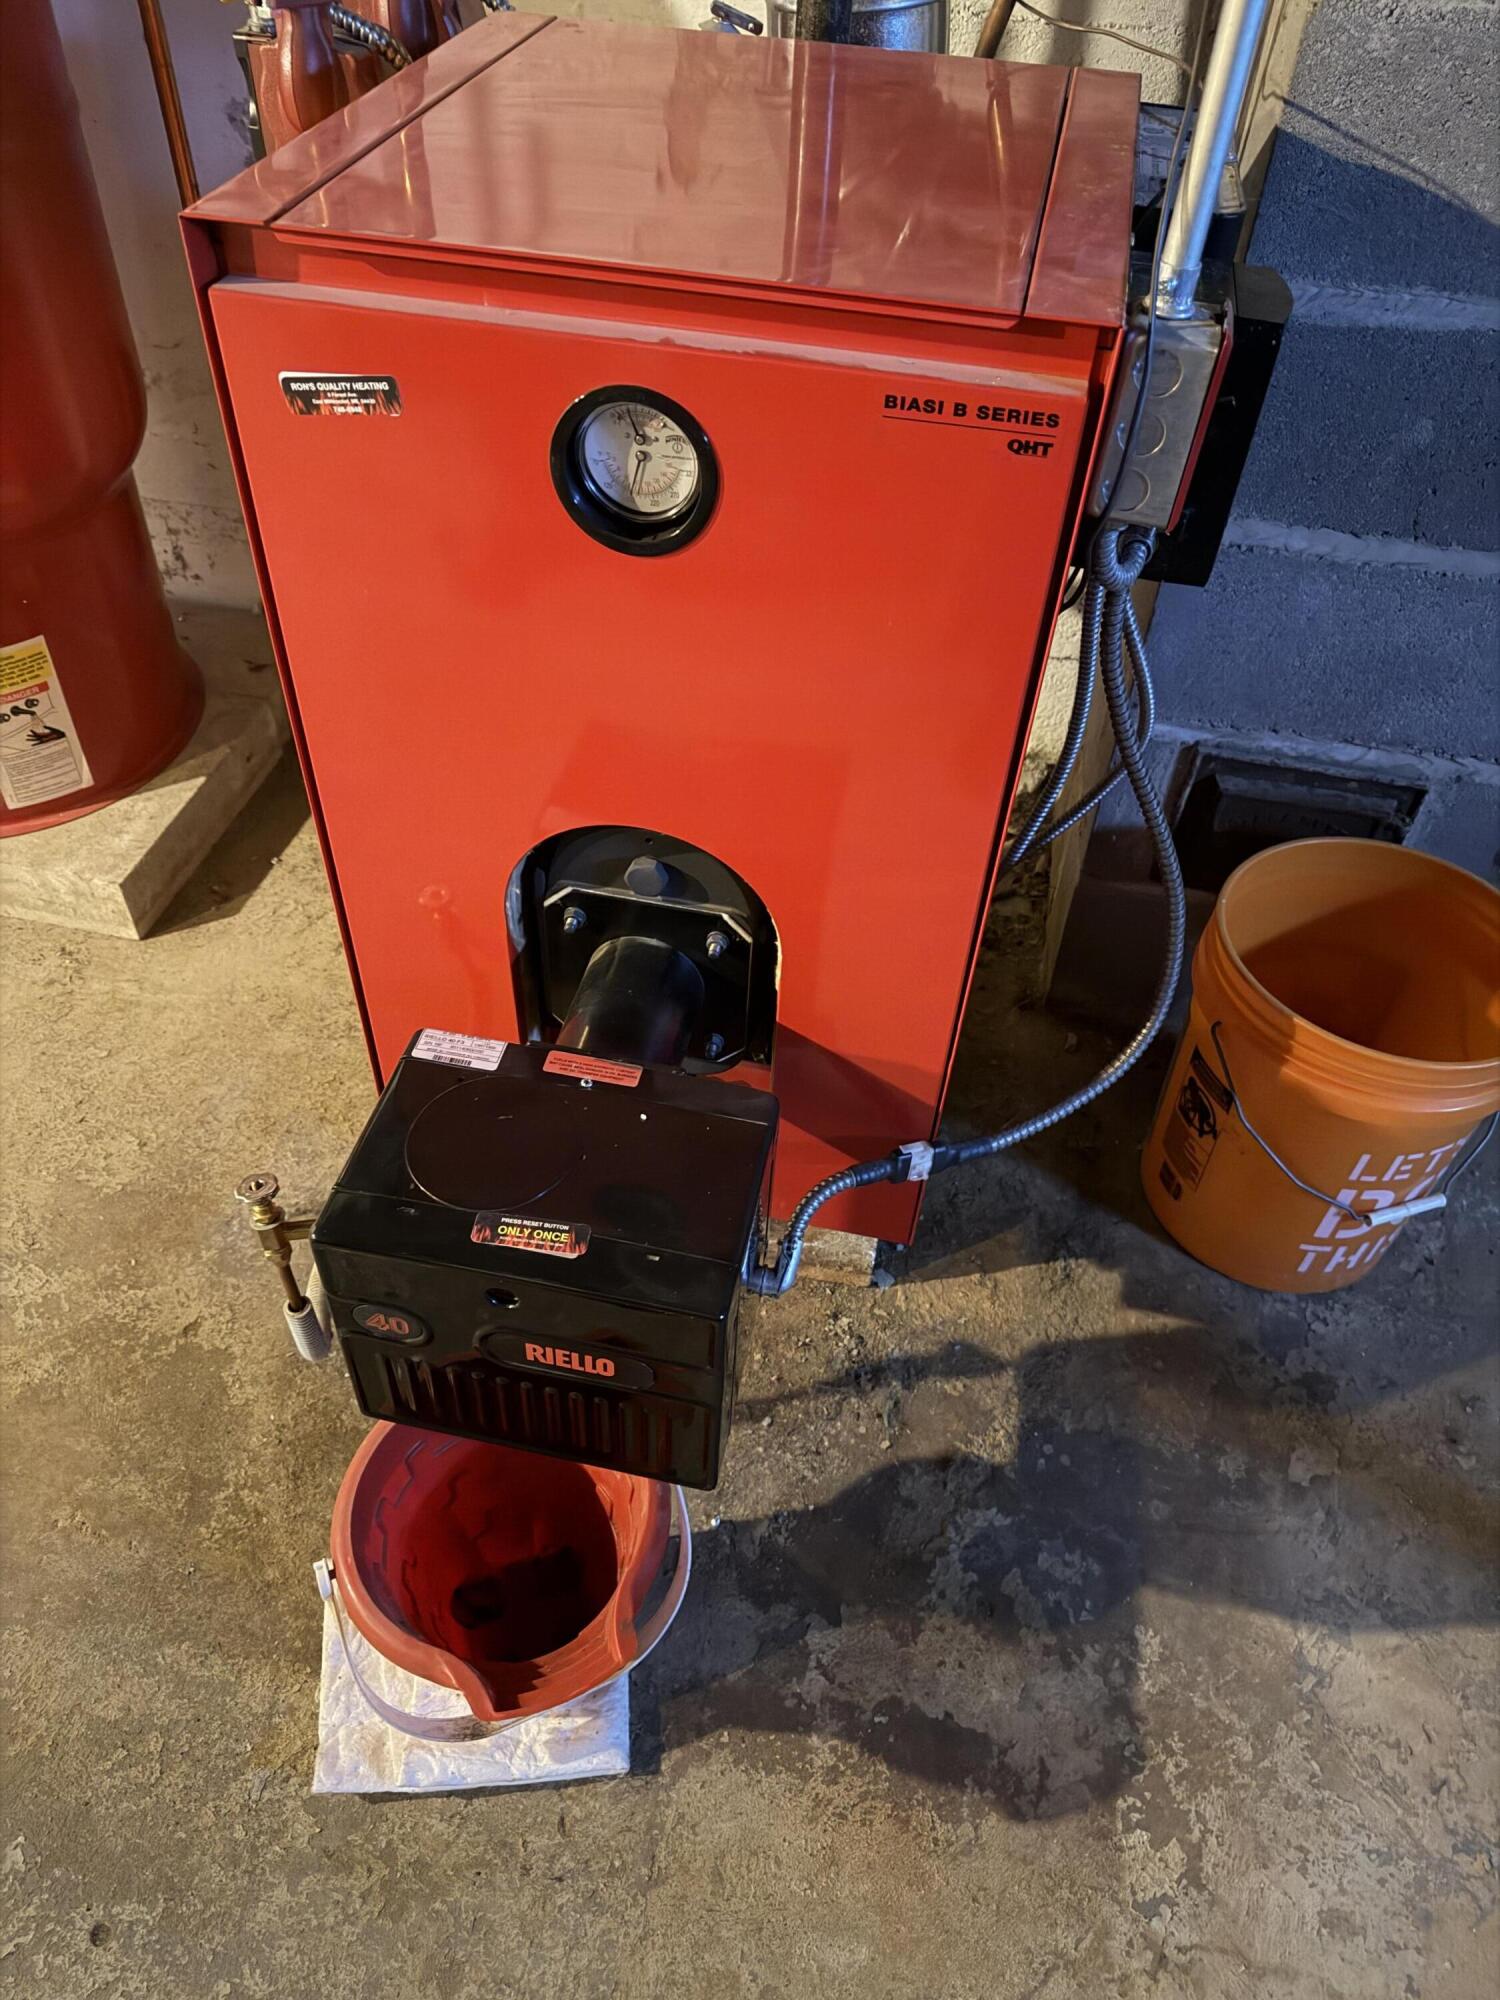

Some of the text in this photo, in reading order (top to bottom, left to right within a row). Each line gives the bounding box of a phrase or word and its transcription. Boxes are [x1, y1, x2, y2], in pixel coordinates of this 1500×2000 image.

[290, 382, 389, 391] RON'S QUALITY HEATING
[884, 394, 1060, 428] BIASI B SERIES
[1007, 439, 1054, 458] QHT
[497, 1225, 532, 1237] ONLY
[533, 1230, 570, 1242] ONCE
[501, 1217, 570, 1231] PRESS RESET BUTTON
[365, 1312, 410, 1335] 40
[525, 1342, 615, 1377] RIELLO
